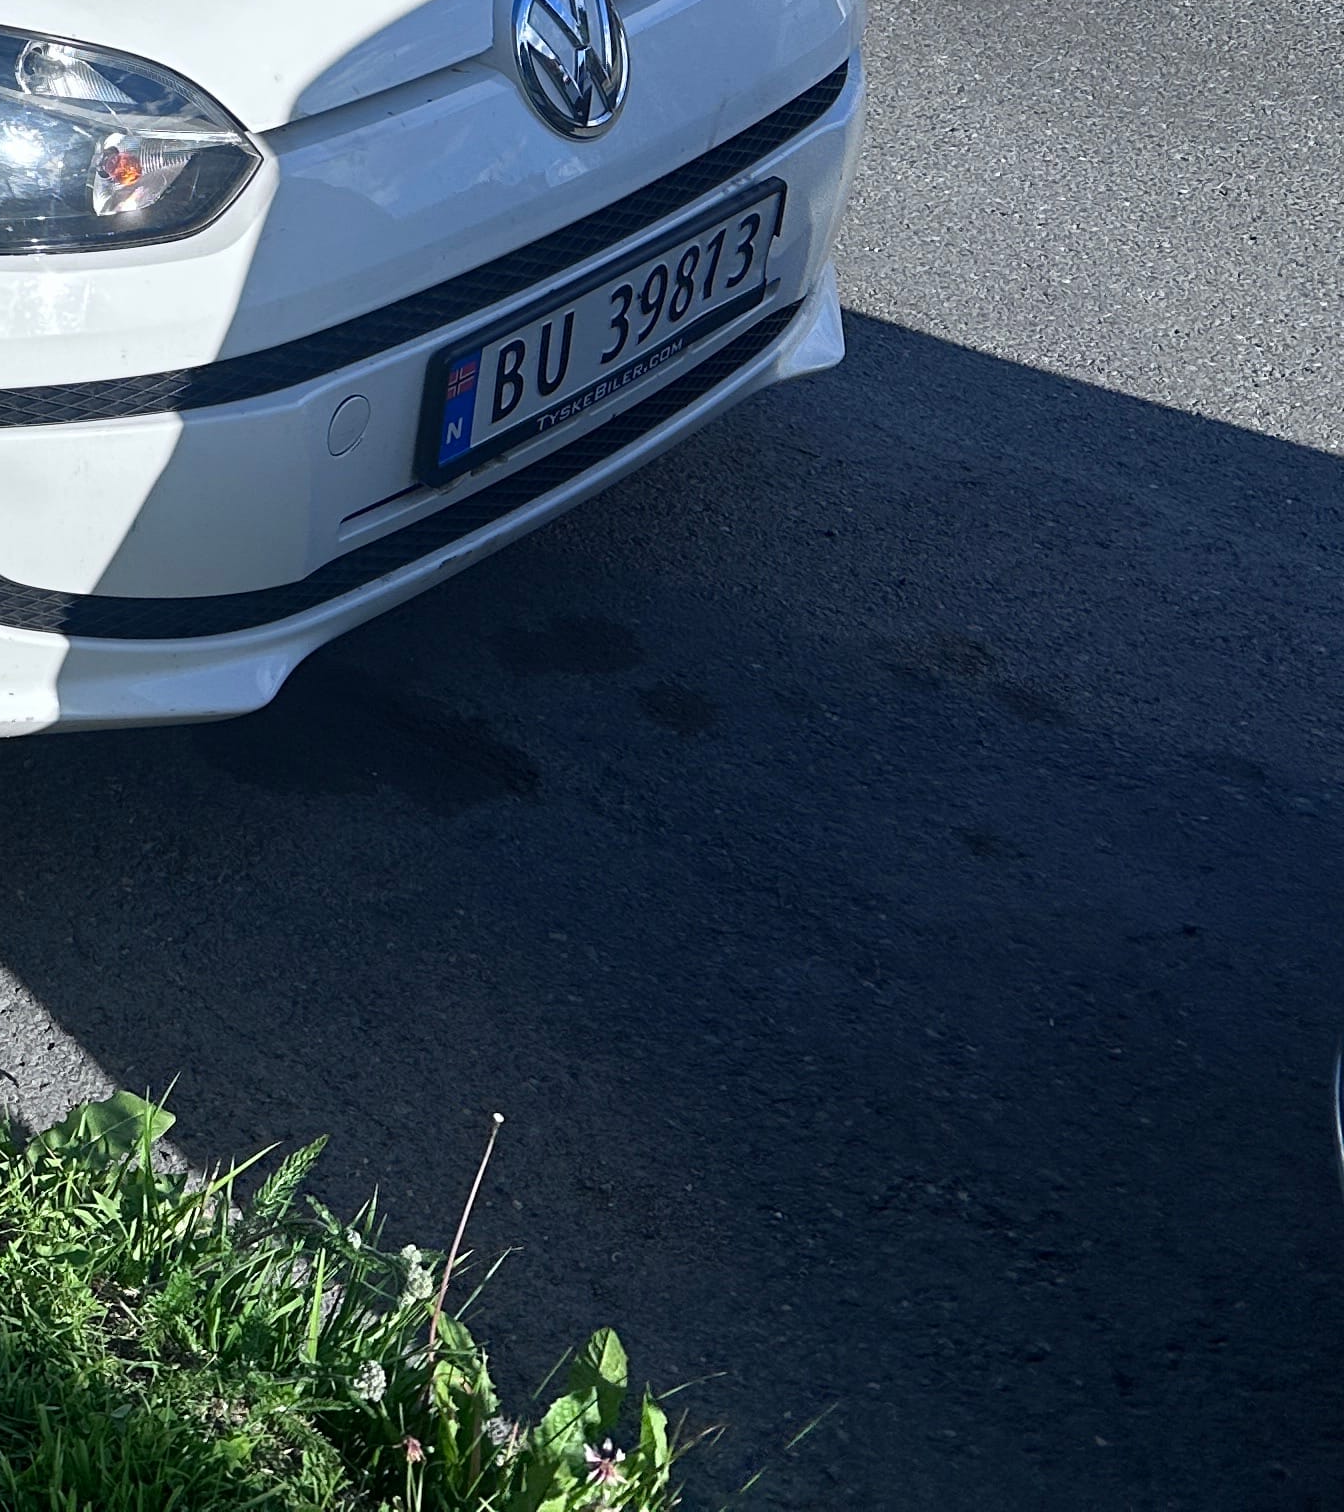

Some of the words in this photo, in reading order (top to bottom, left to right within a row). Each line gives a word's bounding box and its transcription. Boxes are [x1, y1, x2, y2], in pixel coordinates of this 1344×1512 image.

[491, 311, 575, 425] BU
[600, 212, 761, 365] 39813
[446, 416, 463, 444] N
[536, 338, 685, 431] TYSKEBILER.COM
